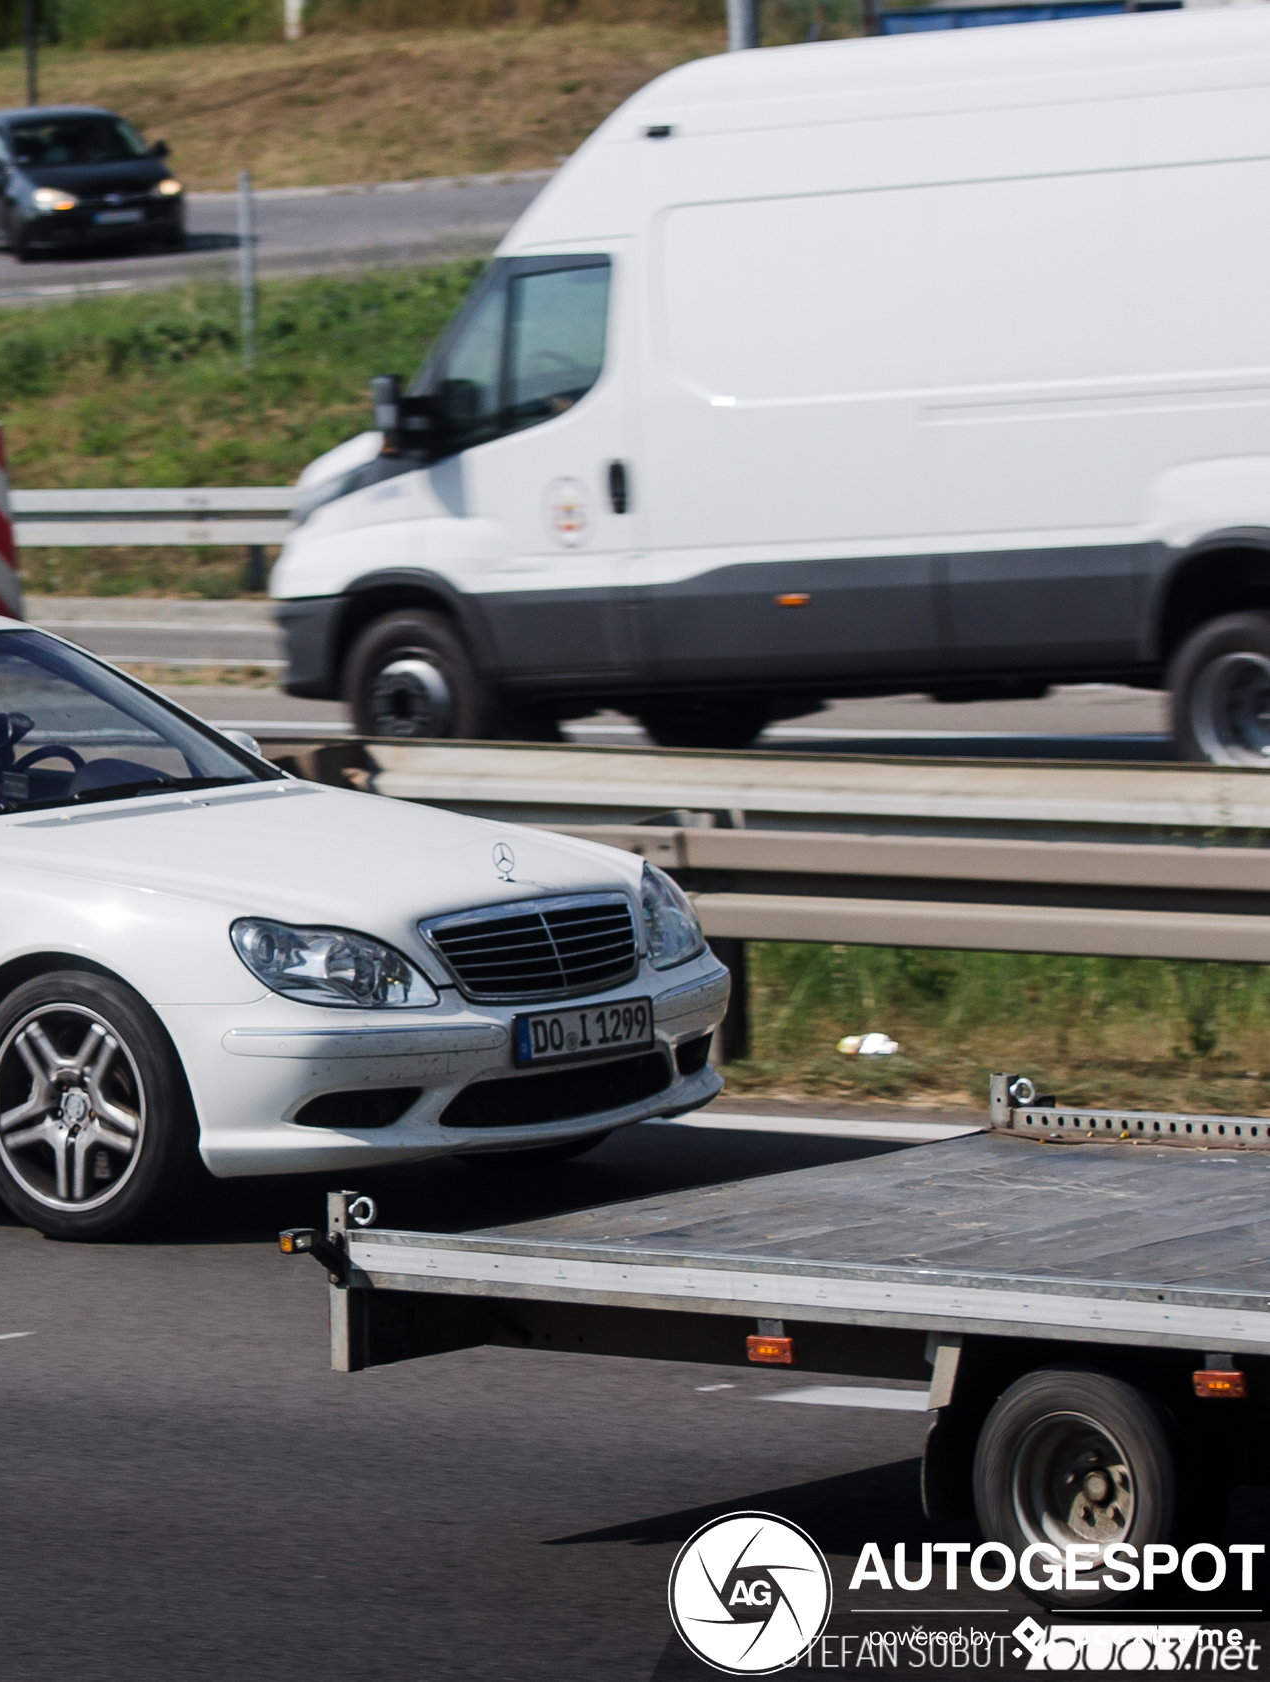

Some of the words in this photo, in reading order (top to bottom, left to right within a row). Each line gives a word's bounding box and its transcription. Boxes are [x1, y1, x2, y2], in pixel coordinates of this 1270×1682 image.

[531, 1017, 564, 1053] DO
[579, 1013, 591, 1047] I
[595, 1004, 647, 1044] 1299
